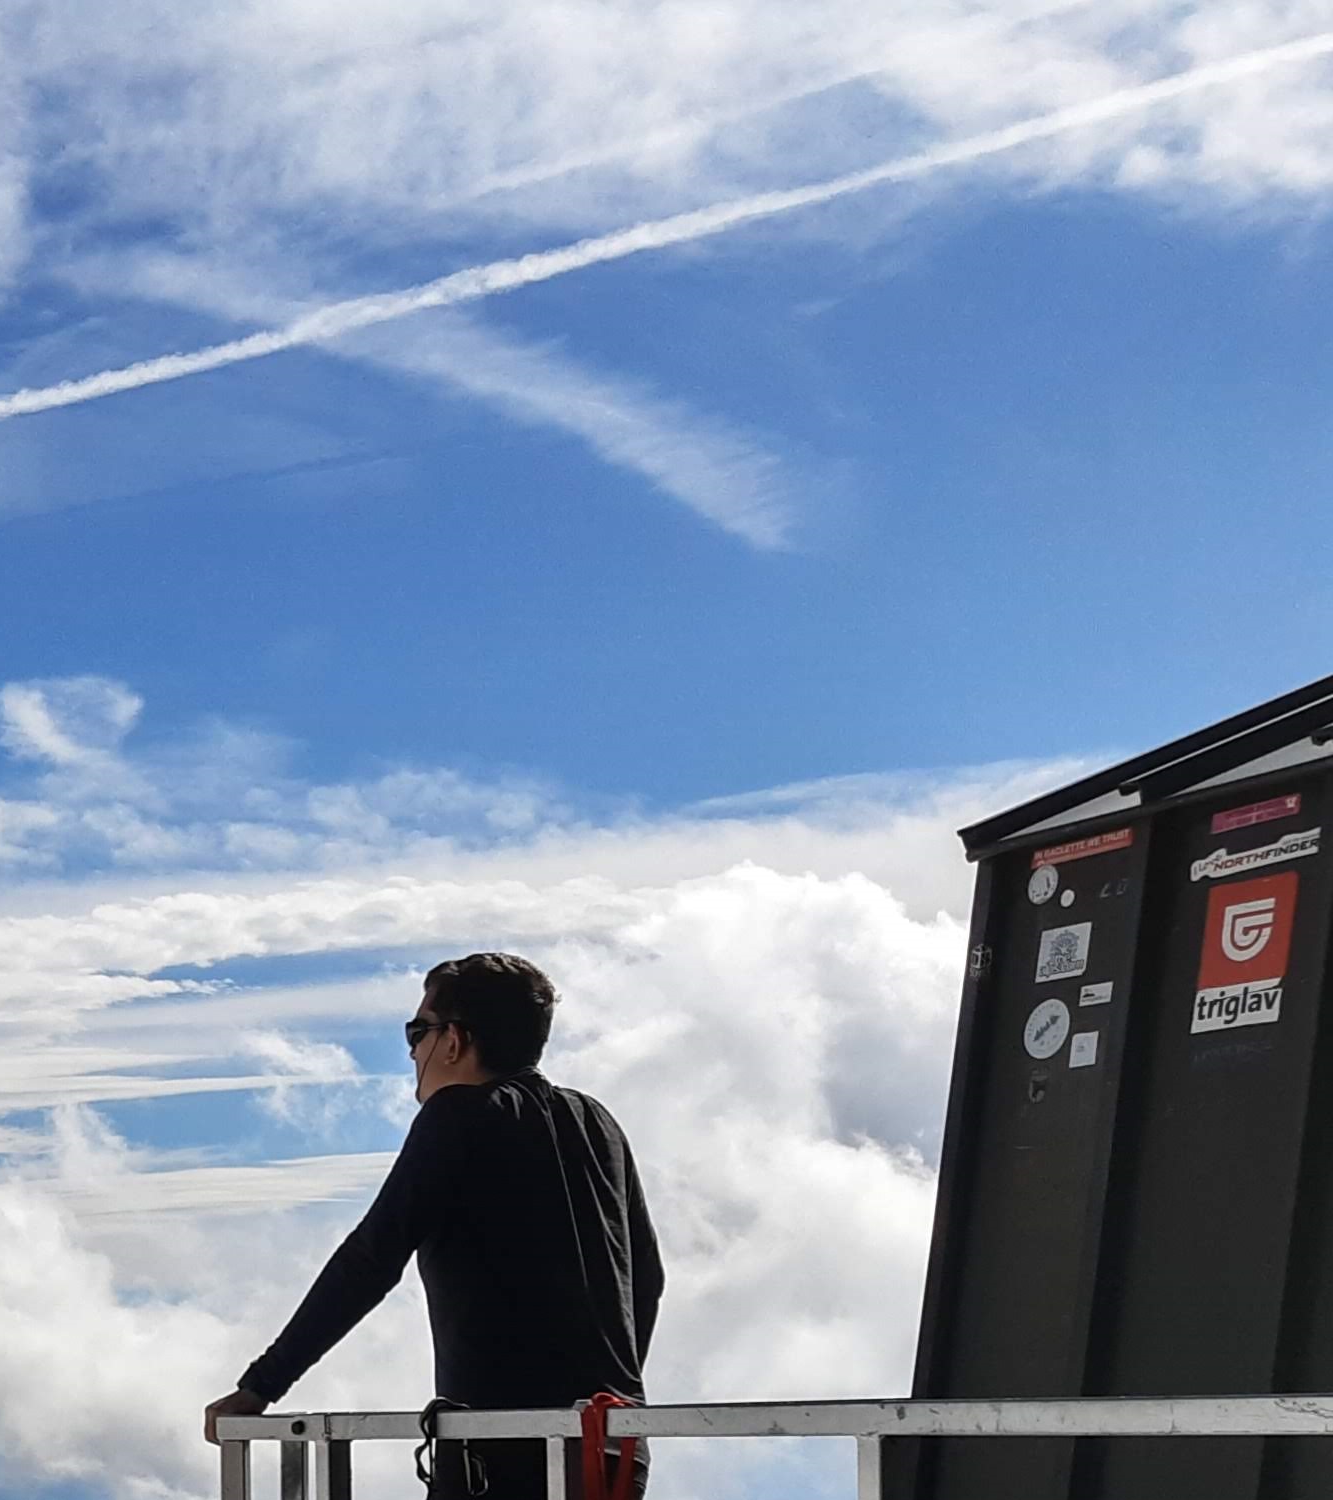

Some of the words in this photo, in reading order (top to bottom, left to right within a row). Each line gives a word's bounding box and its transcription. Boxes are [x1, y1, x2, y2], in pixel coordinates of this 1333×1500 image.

[1087, 836, 1101, 848] WE
[1102, 828, 1130, 844] TRUST
[1212, 838, 1319, 872] NORTHFINDER
[1197, 986, 1279, 1024] triglav
